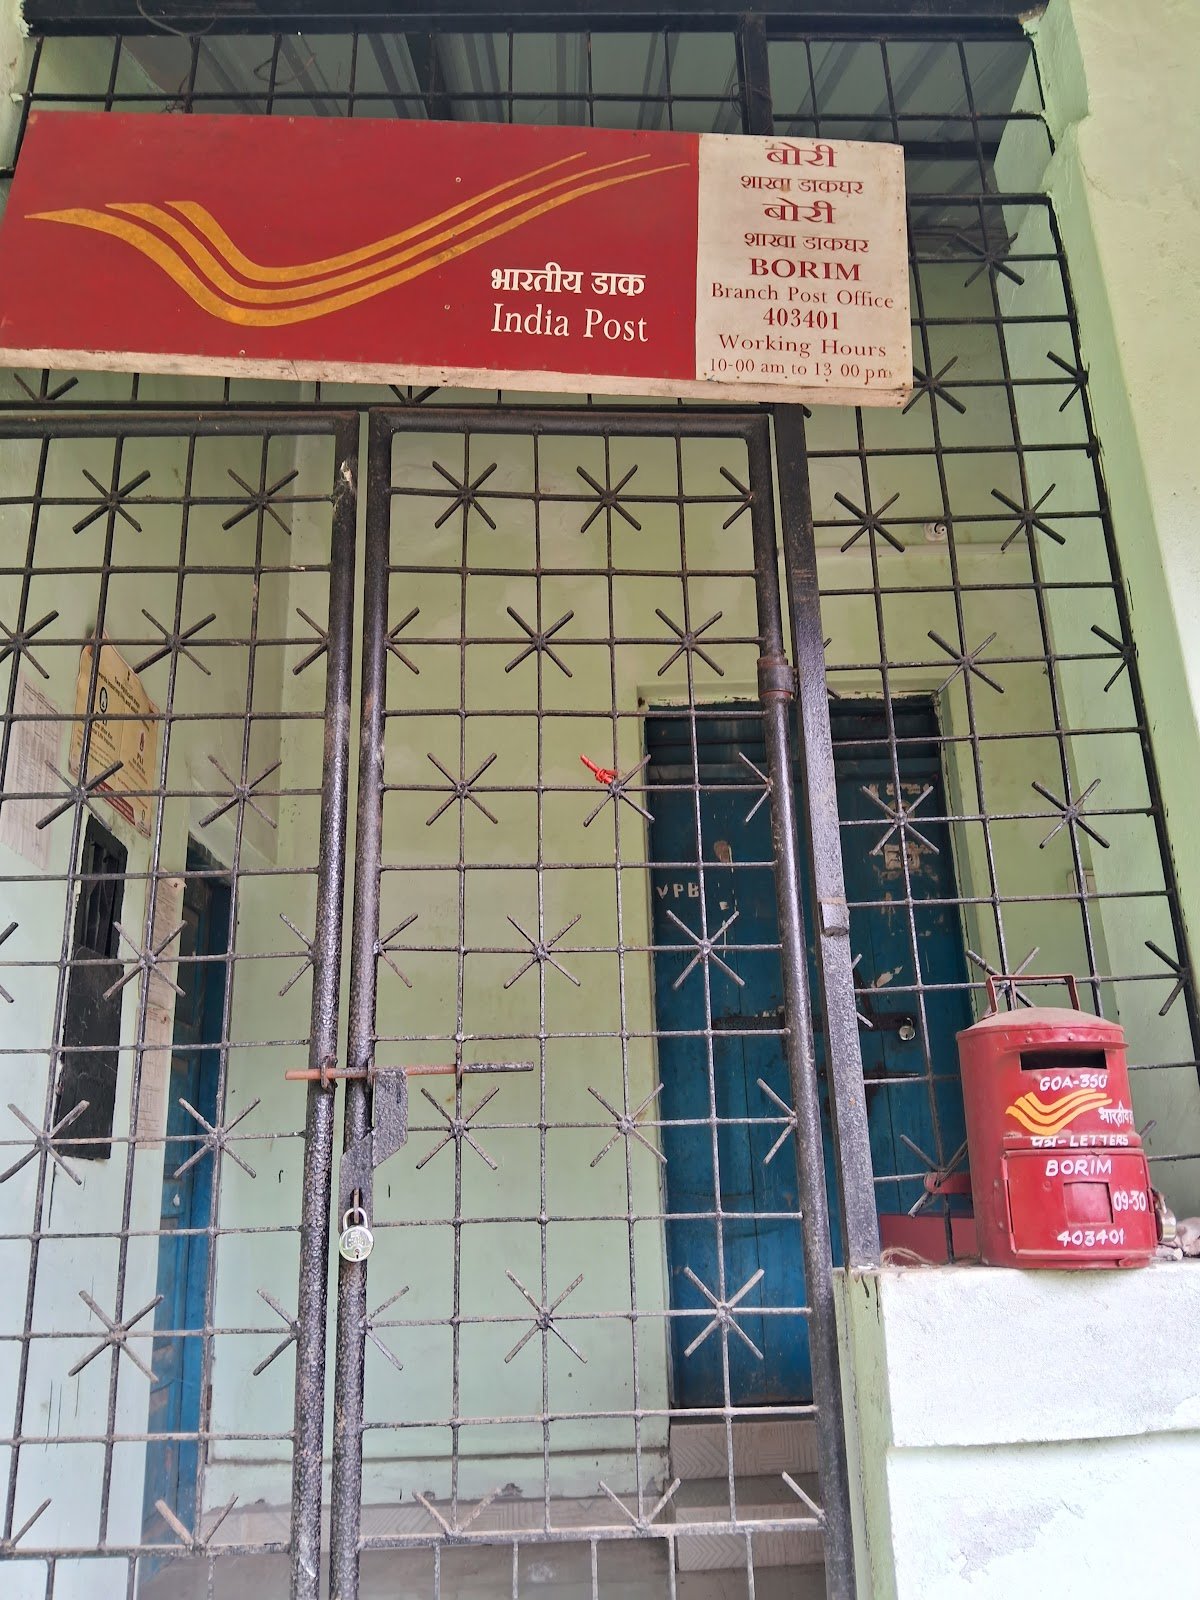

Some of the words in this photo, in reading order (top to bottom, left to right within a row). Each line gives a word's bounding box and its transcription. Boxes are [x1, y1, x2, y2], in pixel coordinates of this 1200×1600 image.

[765, 142, 837, 167] बोरी
[741, 175, 792, 192] शाखा
[798, 179, 864, 197] डाकघर
[762, 197, 836, 224] बोरी
[744, 233, 796, 249] शाखा
[803, 236, 869, 253] डाकघर
[491, 262, 583, 293] भारतीय
[591, 272, 646, 296] डाक
[750, 258, 862, 281] BORIM
[711, 283, 778, 301] Branch
[788, 287, 827, 304] Post
[837, 290, 894, 309] Office
[491, 303, 569, 336] India
[583, 308, 648, 342] Post
[763, 308, 839, 329] 403401
[719, 334, 811, 357] Working
[821, 339, 886, 357] Hours
[710, 358, 755, 373] 10-00
[761, 362, 785, 374] am
[792, 362, 807, 376] to
[1045, 1159, 1112, 1177] BORIM
[1113, 1190, 1146, 1212] 09-30
[1057, 1229, 1125, 1247] 403401
